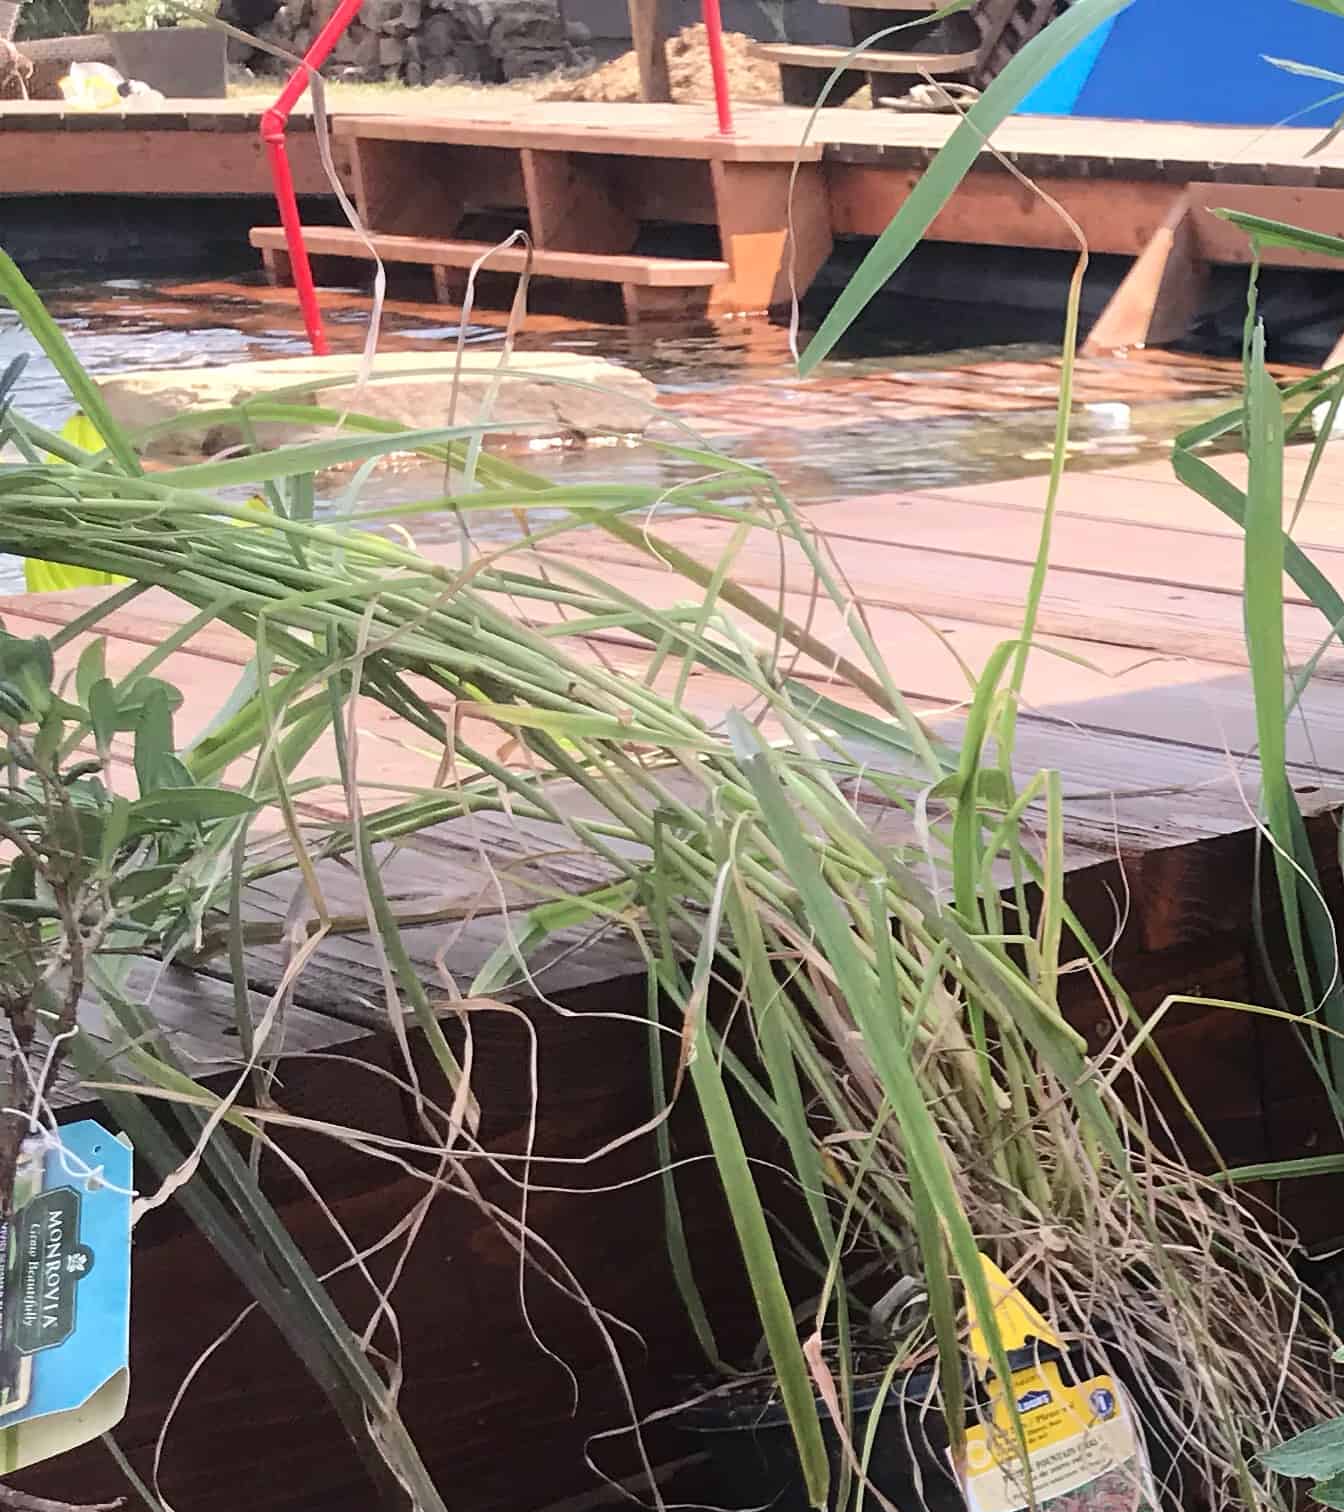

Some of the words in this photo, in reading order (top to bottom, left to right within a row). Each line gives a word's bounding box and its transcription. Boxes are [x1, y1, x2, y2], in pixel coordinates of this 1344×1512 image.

[27, 1222, 41, 1258] Grow
[42, 1209, 63, 1329] MONROVIA
[23, 1261, 40, 1328] Beautifully
